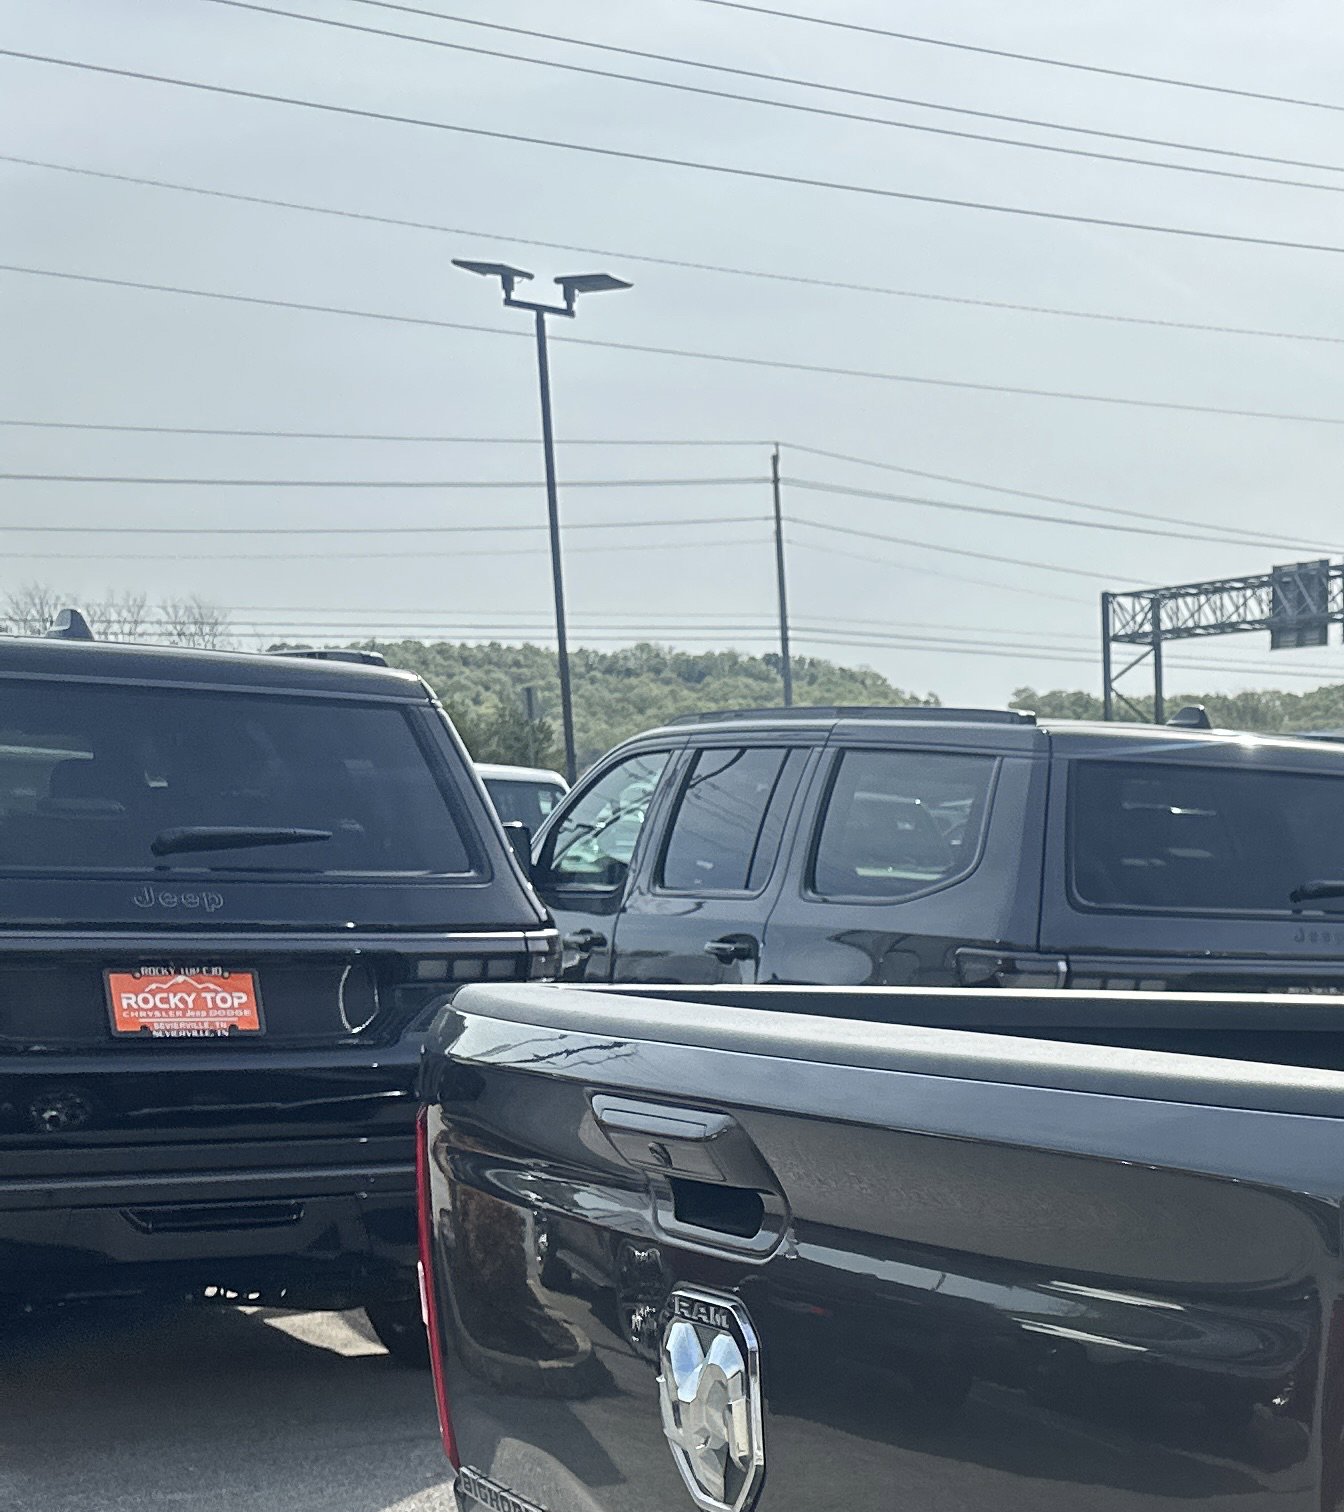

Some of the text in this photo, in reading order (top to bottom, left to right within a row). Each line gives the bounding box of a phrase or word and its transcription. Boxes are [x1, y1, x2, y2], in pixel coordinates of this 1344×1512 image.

[133, 886, 224, 913] Jeep
[140, 966, 175, 977] ROCKY
[121, 991, 248, 1010] ROCKY TOP
[122, 1009, 252, 1018] CHRYSLER Jeep DODGE
[674, 1296, 730, 1329] RAM
